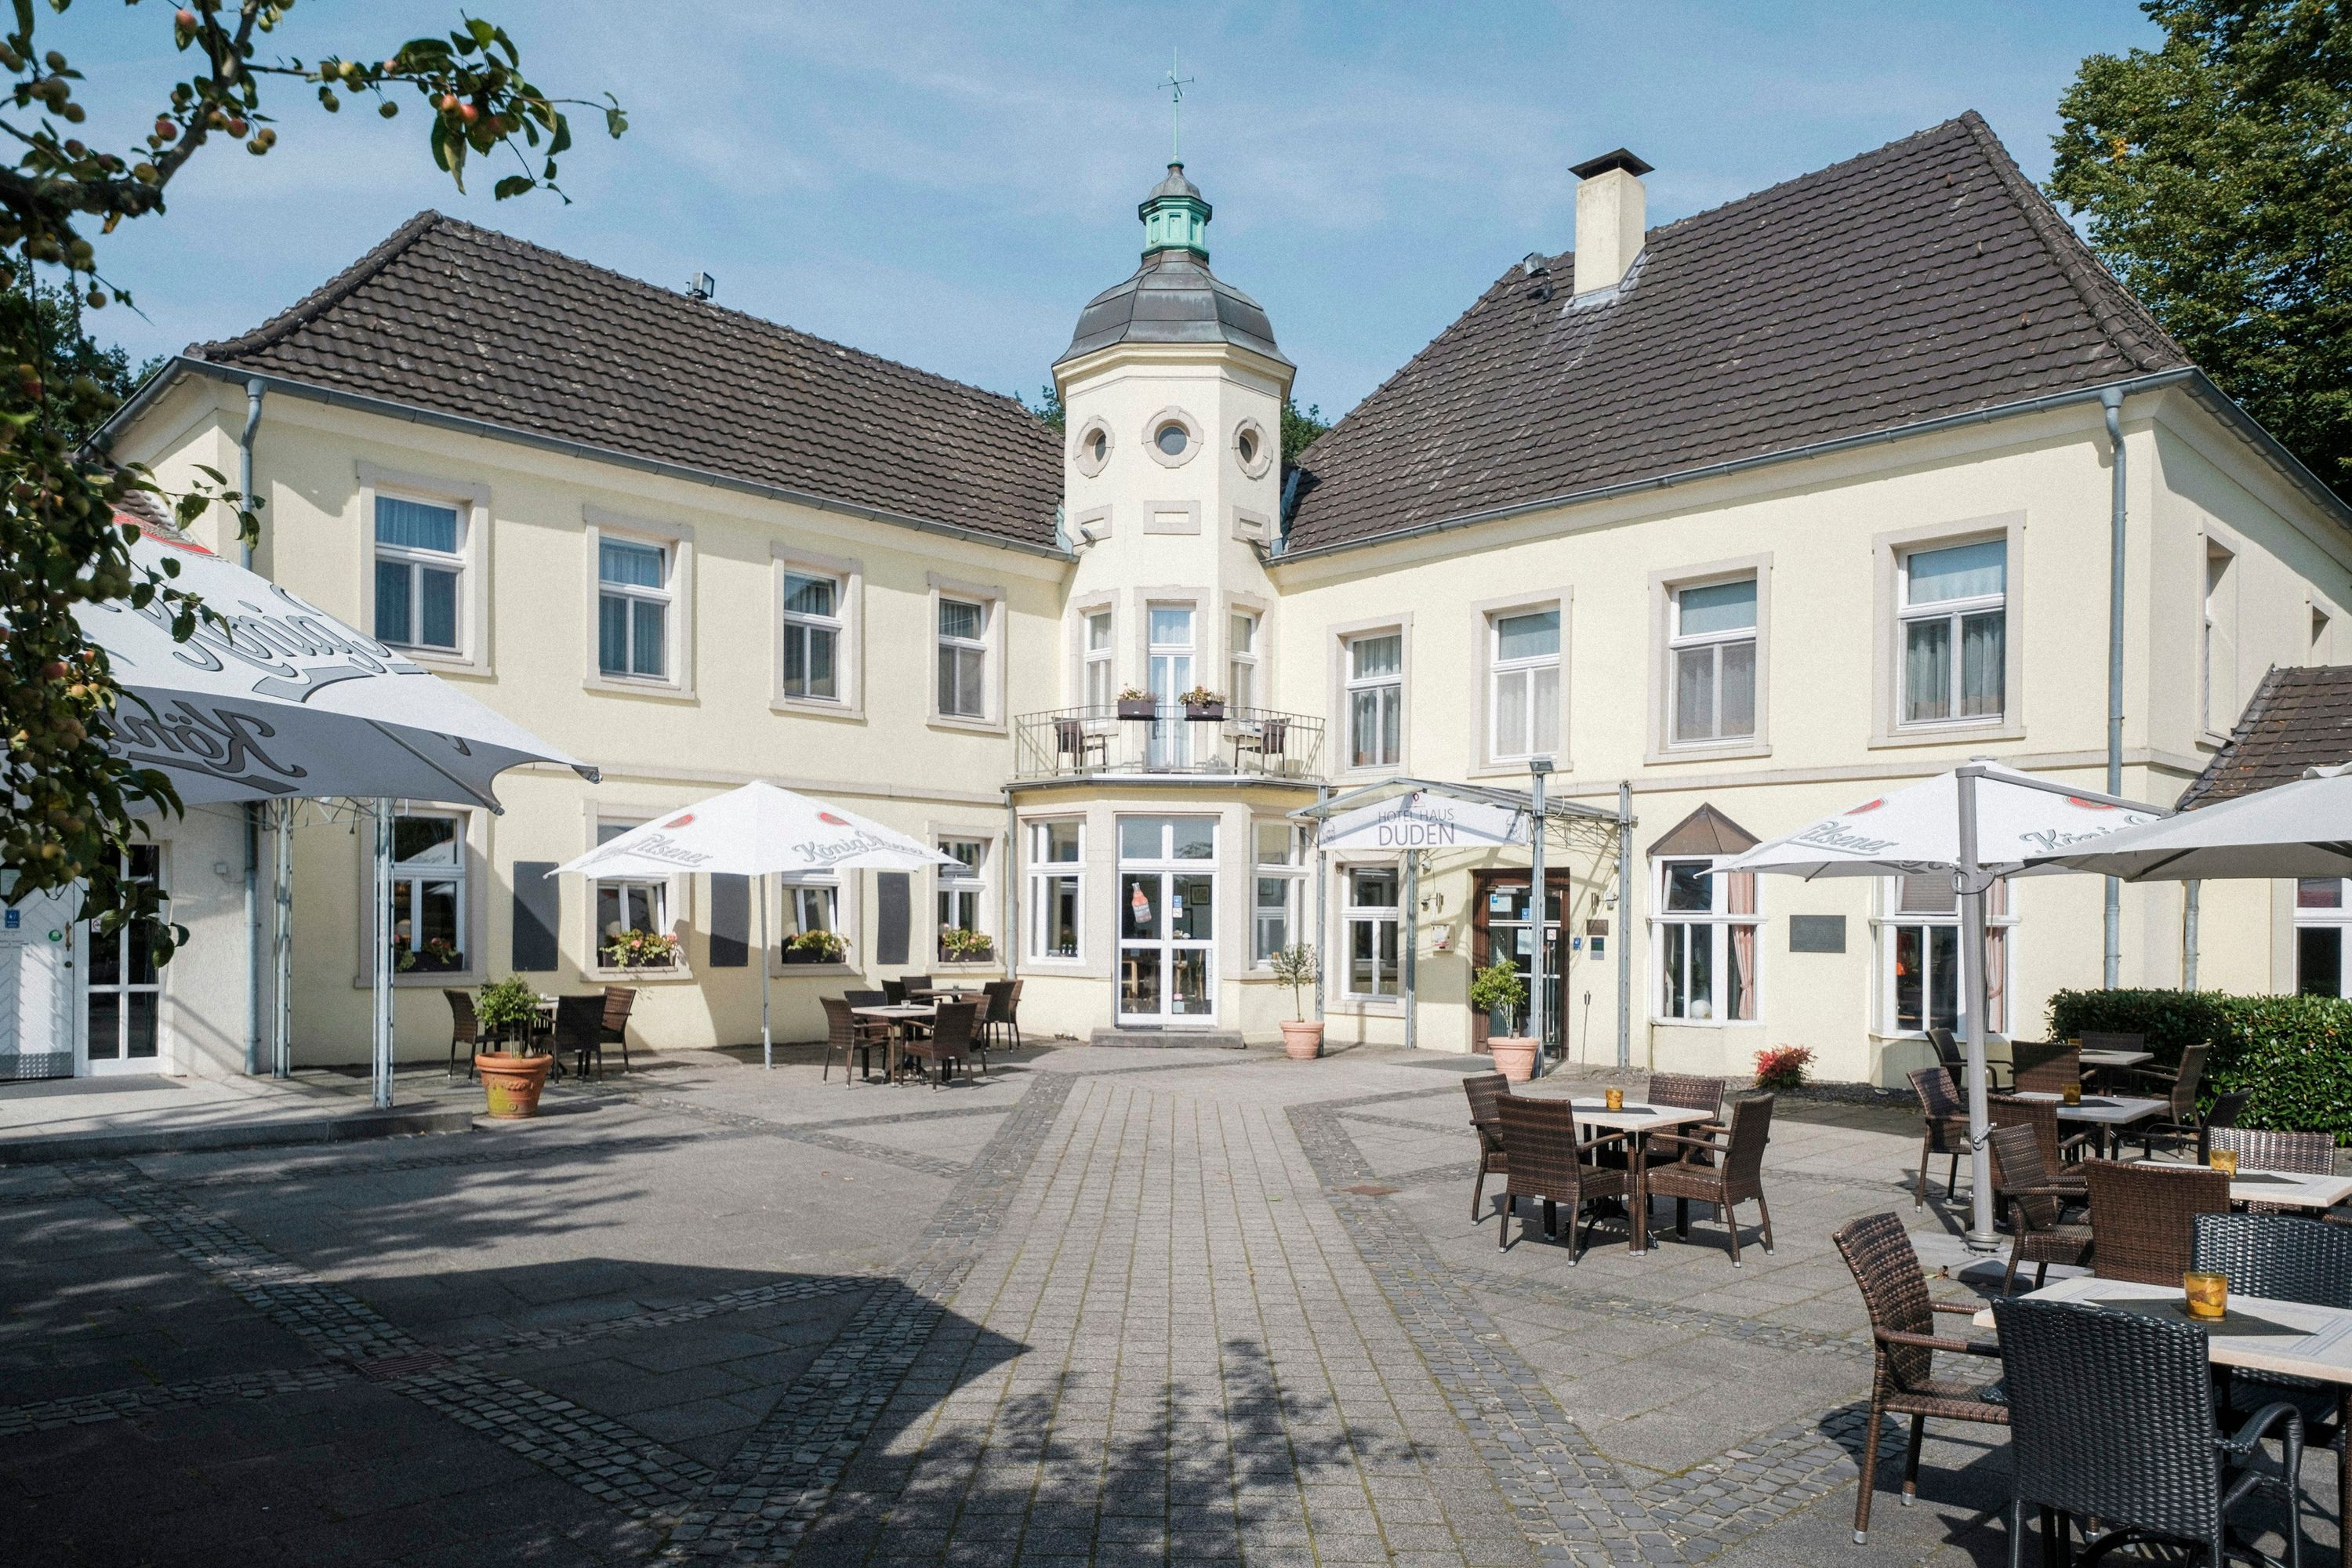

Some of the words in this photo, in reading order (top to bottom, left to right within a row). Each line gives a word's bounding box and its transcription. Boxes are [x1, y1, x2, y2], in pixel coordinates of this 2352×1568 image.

[1378, 810, 1414, 822] HOTEL
[1420, 809, 1454, 822] HAUS
[1380, 823, 1454, 846] DUDEN
[1798, 822, 1900, 851] Pilsener
[2018, 826, 2132, 853] Kön
[792, 838, 869, 862] König
